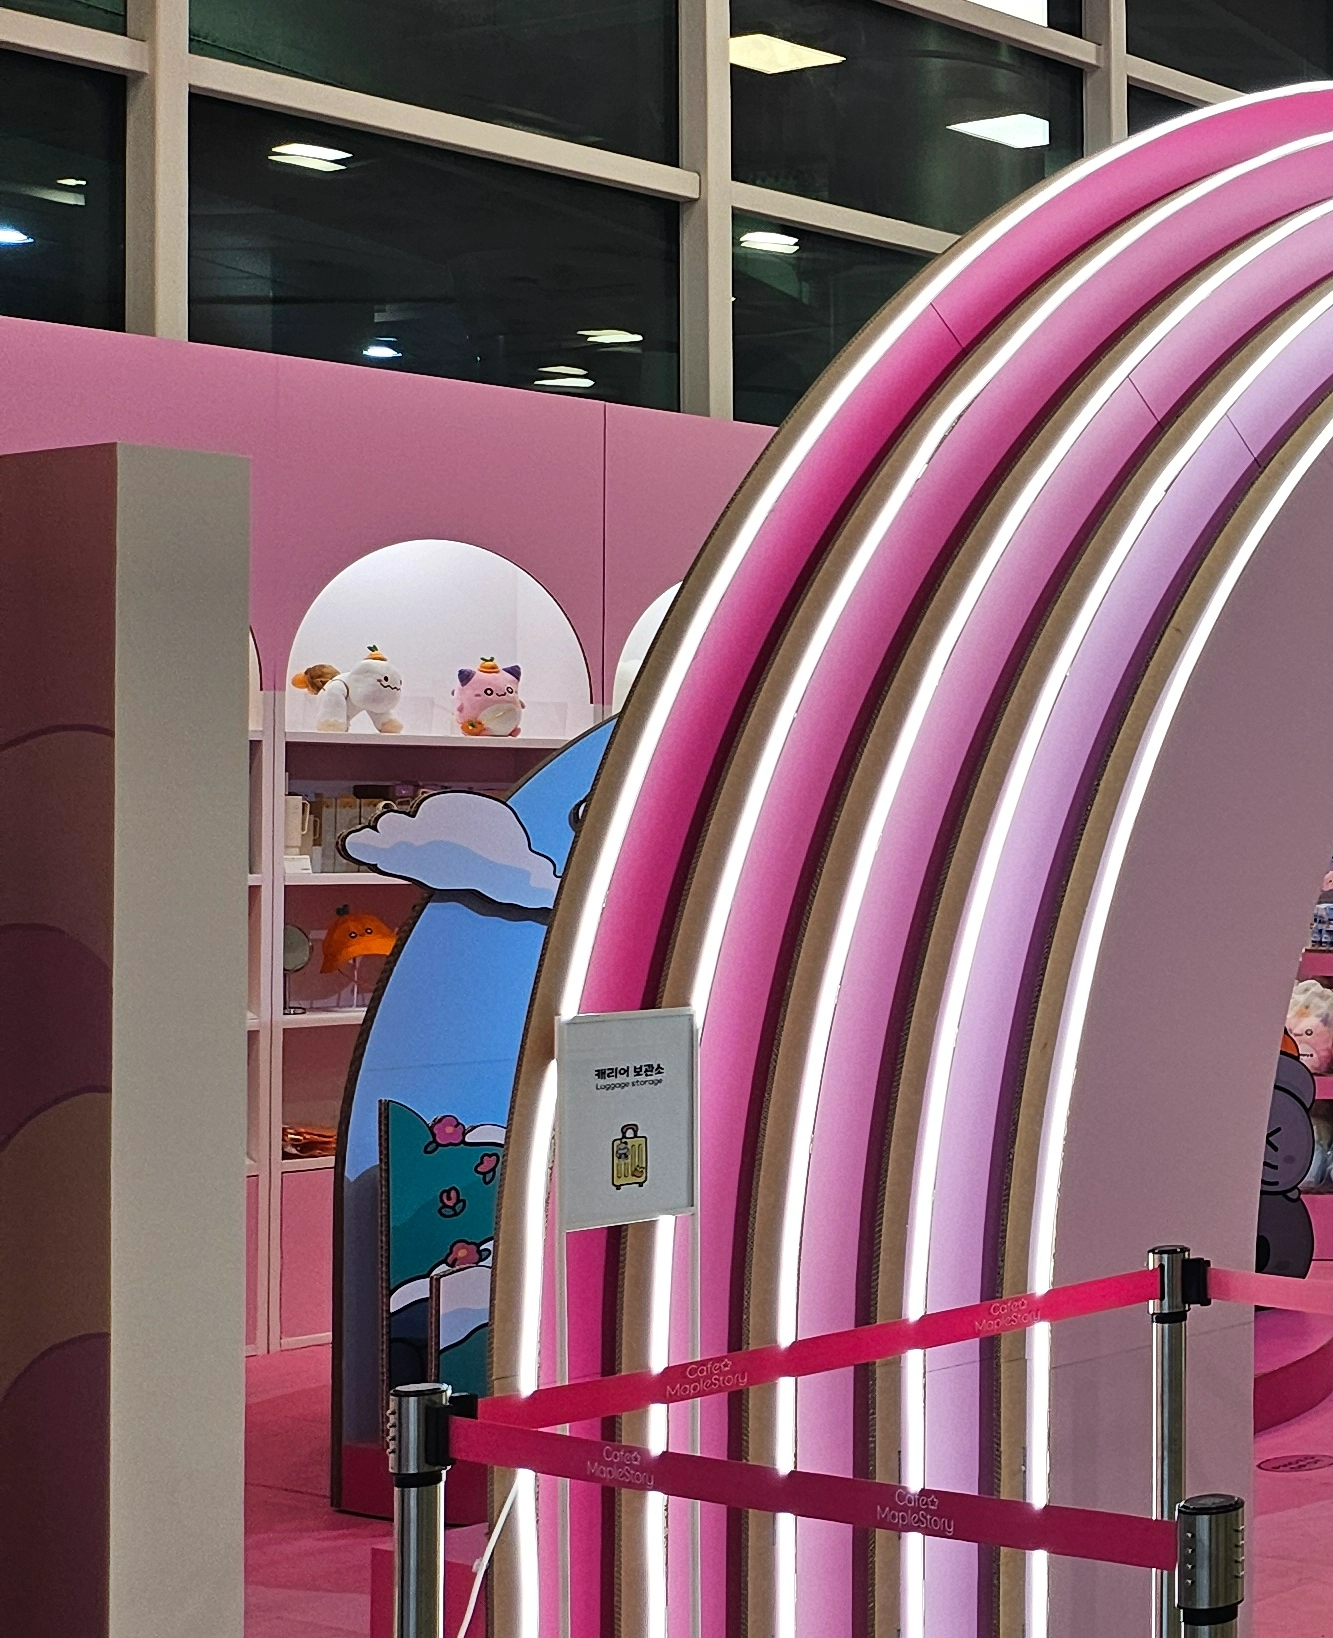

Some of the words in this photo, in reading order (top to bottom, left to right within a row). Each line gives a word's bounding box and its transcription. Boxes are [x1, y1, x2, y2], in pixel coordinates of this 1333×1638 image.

[594, 1066, 630, 1080] 캐리어
[633, 1063, 665, 1077] 보관소
[595, 1081, 630, 1091] Luggage
[631, 1078, 663, 1087] storage
[990, 1300, 1020, 1317] Cafe
[975, 1308, 1042, 1334] MapleStory
[686, 1361, 722, 1380] Cafe
[665, 1371, 749, 1399] MapleStory
[602, 1446, 633, 1464] Cafe
[586, 1460, 655, 1488] MapleStory
[895, 1489, 928, 1508] Cafe
[876, 1504, 954, 1536] MapleStory
